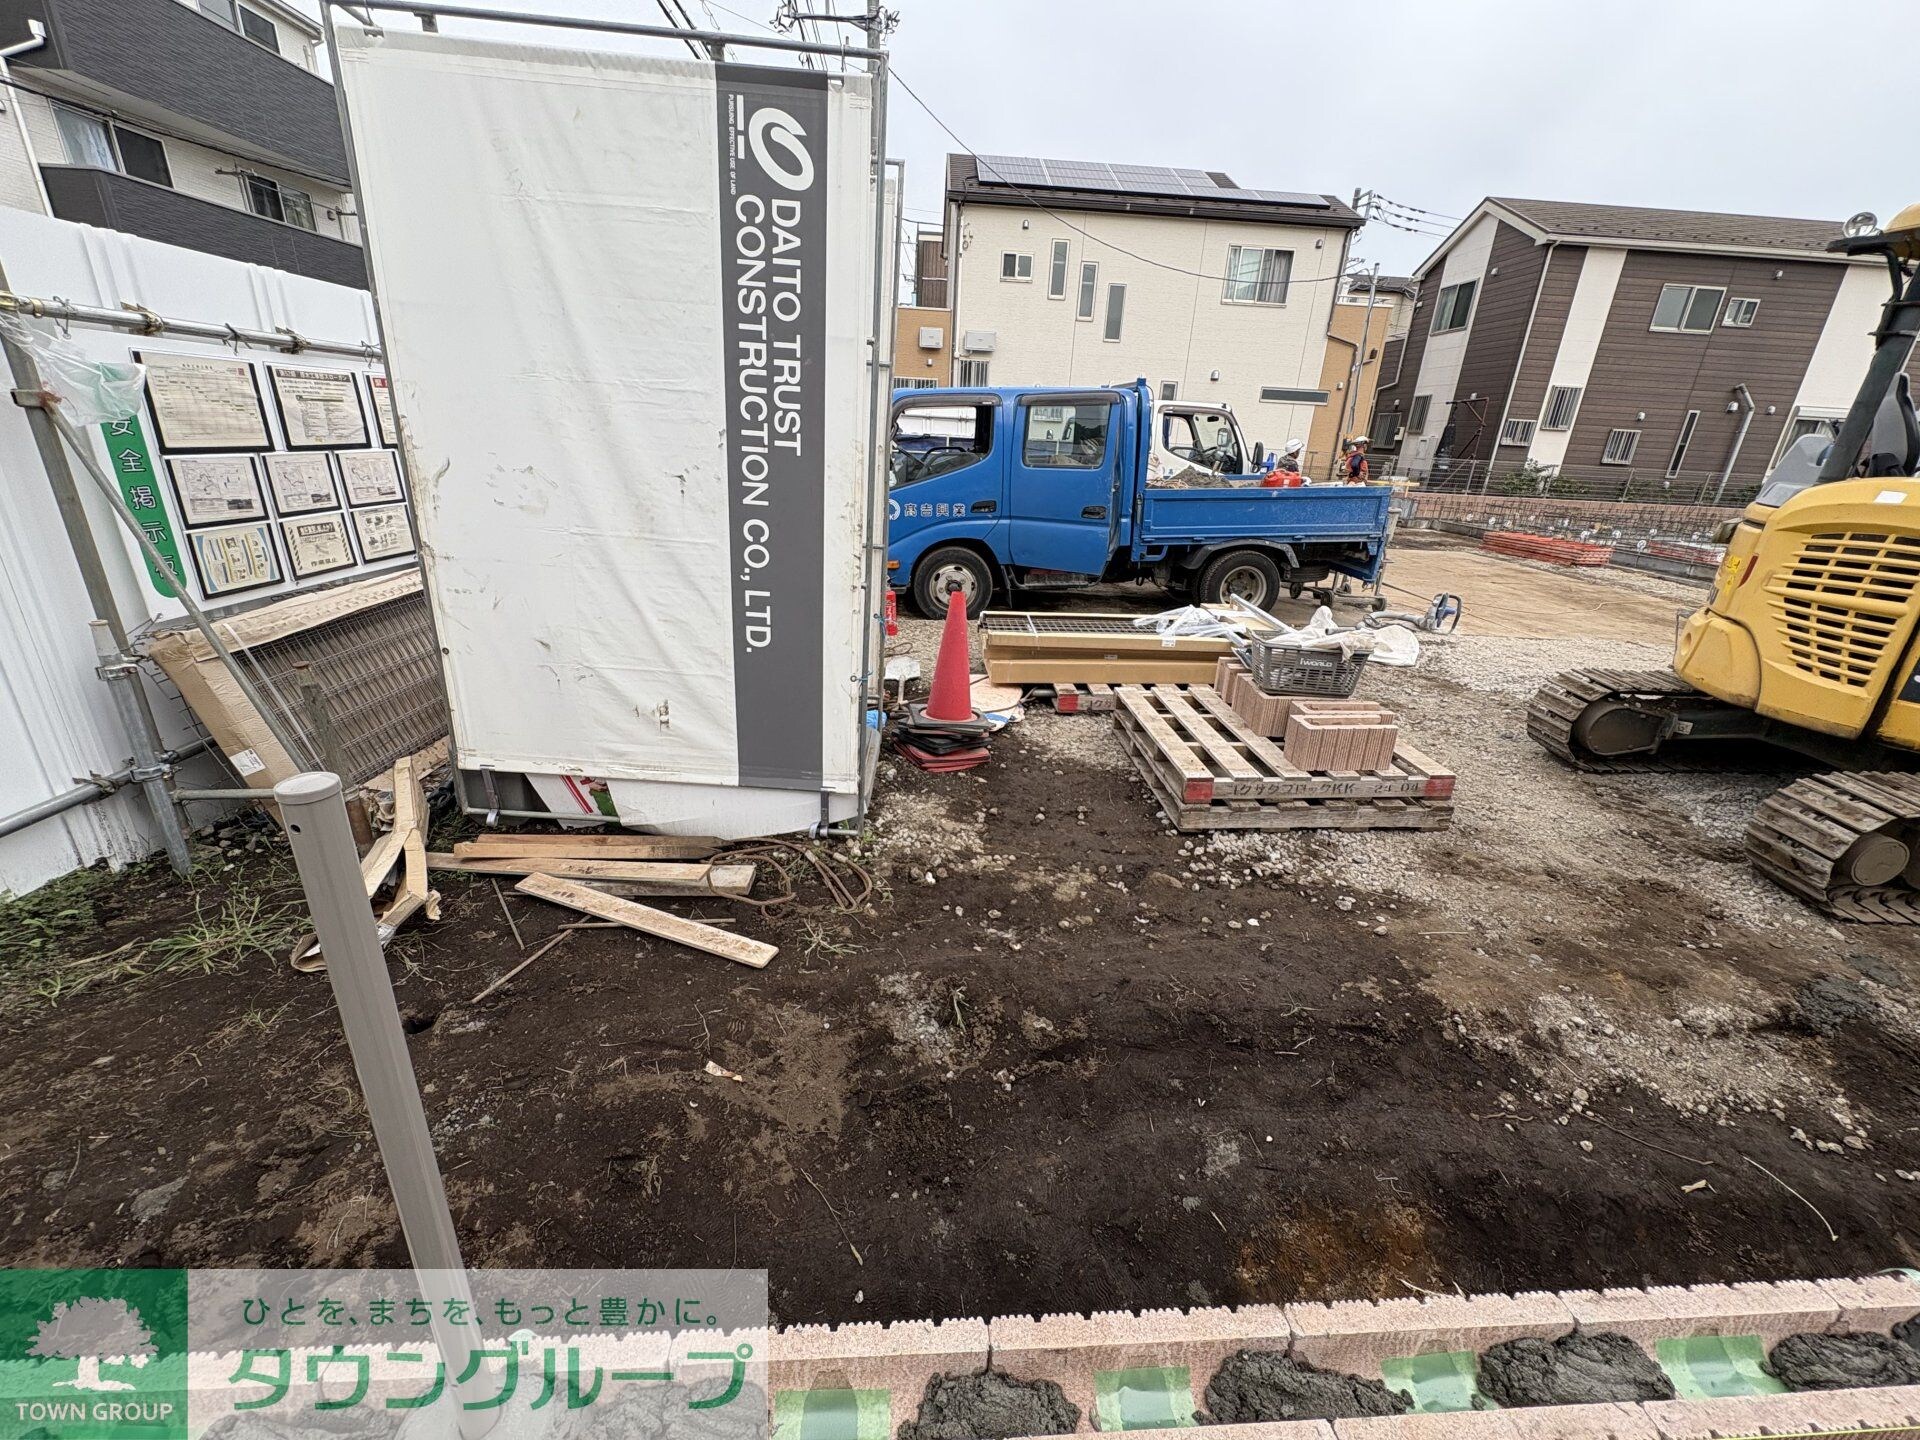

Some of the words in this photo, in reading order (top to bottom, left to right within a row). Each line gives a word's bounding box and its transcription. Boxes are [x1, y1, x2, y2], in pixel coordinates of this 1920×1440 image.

[771, 198, 801, 322] DAITO
[735, 194, 769, 506] CONSTRUCTION
[772, 334, 801, 457] TRUST
[740, 518, 770, 581] CO.,
[744, 589, 772, 653] LTD.
